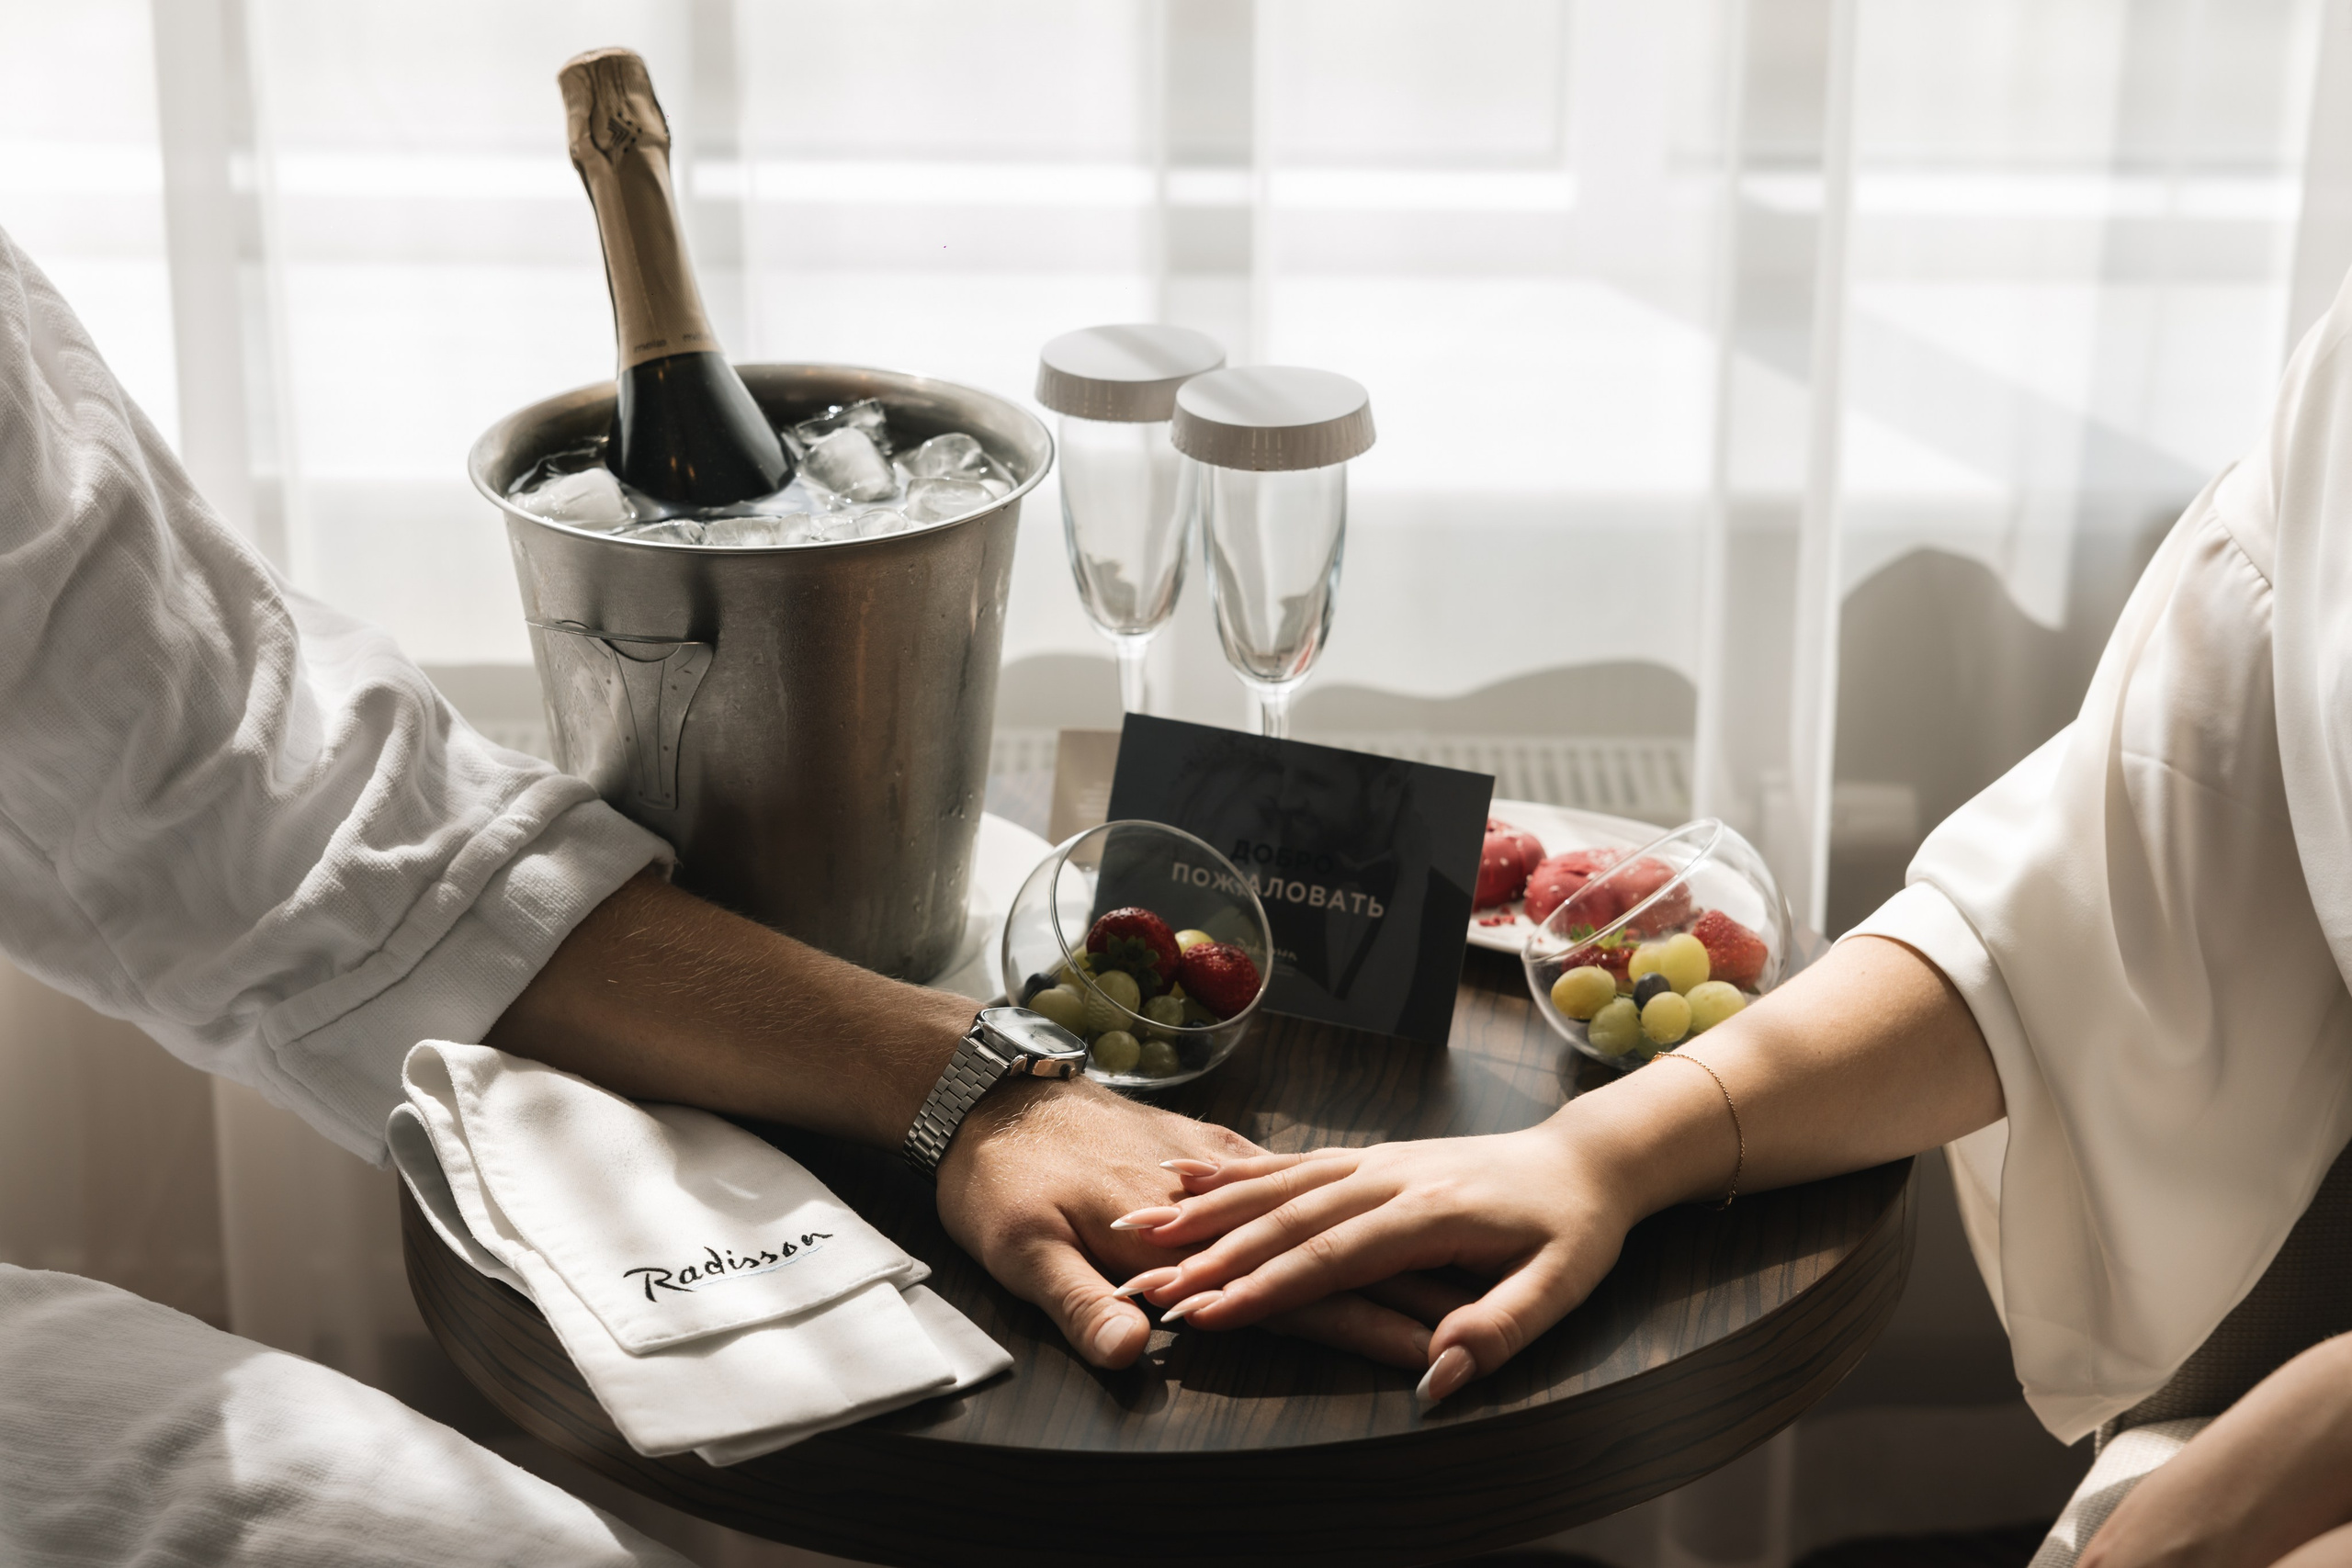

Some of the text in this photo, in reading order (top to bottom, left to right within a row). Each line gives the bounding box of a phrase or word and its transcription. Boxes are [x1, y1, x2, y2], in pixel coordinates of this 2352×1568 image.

[1230, 839, 1334, 874] ДОБРО
[1171, 863, 1385, 918] ПОЖАЛОВАТЬ
[623, 1232, 833, 1303] Radisson
